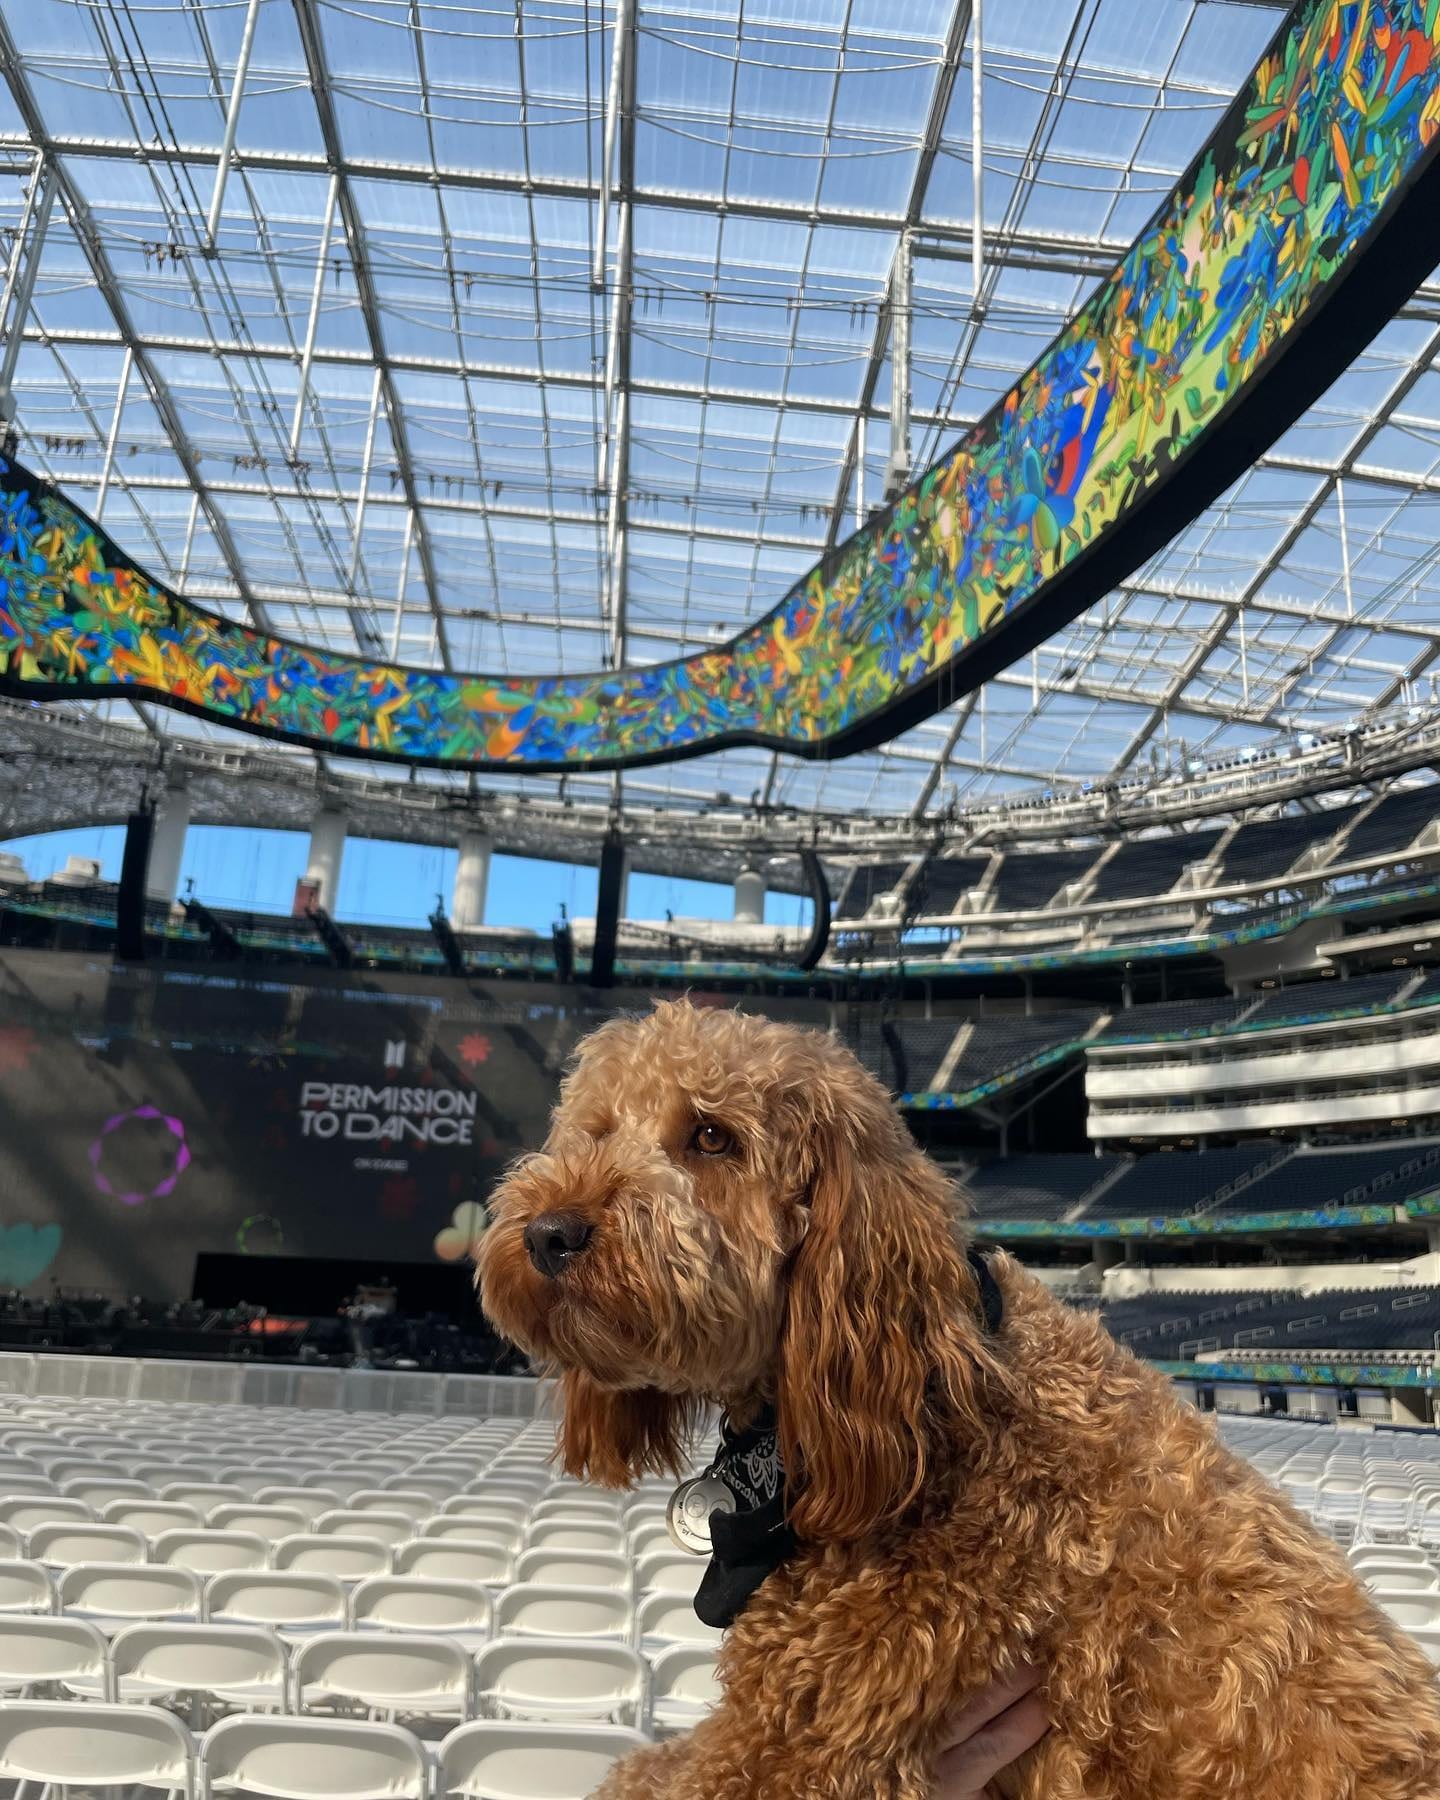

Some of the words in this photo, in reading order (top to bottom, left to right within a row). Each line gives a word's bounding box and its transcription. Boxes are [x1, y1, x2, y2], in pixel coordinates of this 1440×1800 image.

[301, 1082, 477, 1116] PERMISSION
[301, 1110, 340, 1138] TO
[344, 1111, 474, 1145] DANCE
